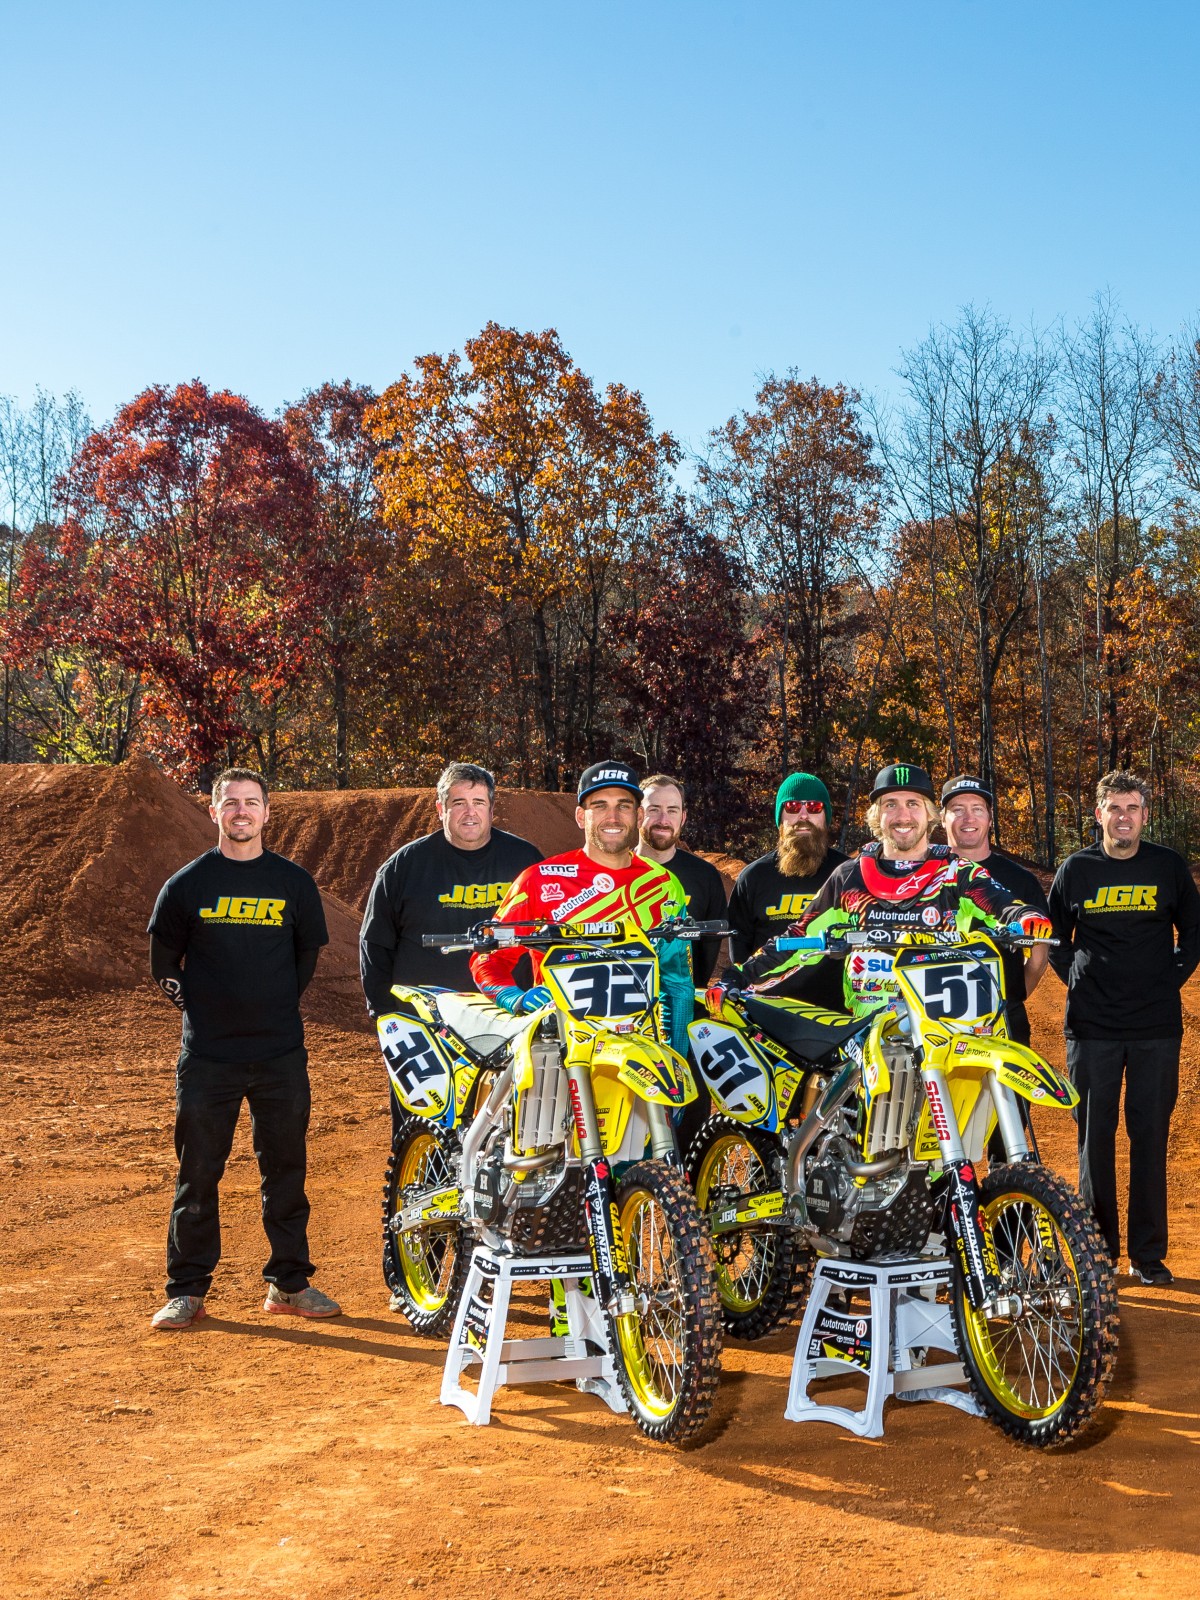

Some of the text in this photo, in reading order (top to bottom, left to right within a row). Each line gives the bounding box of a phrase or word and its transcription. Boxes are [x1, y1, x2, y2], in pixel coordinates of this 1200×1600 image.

[592, 769, 629, 782] JGR
[951, 780, 980, 790] JGR
[199, 896, 286, 920] JGR
[553, 887, 597, 920] Autotrader
[766, 893, 816, 915] JG
[1083, 885, 1157, 908] JGR
[868, 910, 920, 921] Autotrader
[568, 963, 653, 1018] 32
[925, 963, 993, 1022] 51
[383, 1031, 446, 1096] 32
[700, 1036, 763, 1100] 51
[625, 1070, 650, 1089] Autotrader
[1004, 1072, 1033, 1091] Autotrader
[428, 1091, 445, 1110] JGR
[569, 1079, 587, 1139] SHOWA
[748, 1095, 765, 1113] JGR
[925, 1080, 951, 1141] SHOWA
[719, 1208, 737, 1223] JGR
[596, 1213, 611, 1277] DUNLOP
[609, 1202, 629, 1274] GALFER
[966, 1216, 984, 1280] DUNLOP
[982, 1248, 992, 1275] USA
[821, 1317, 855, 1332] Autotrader
[810, 1339, 821, 1350] 51
